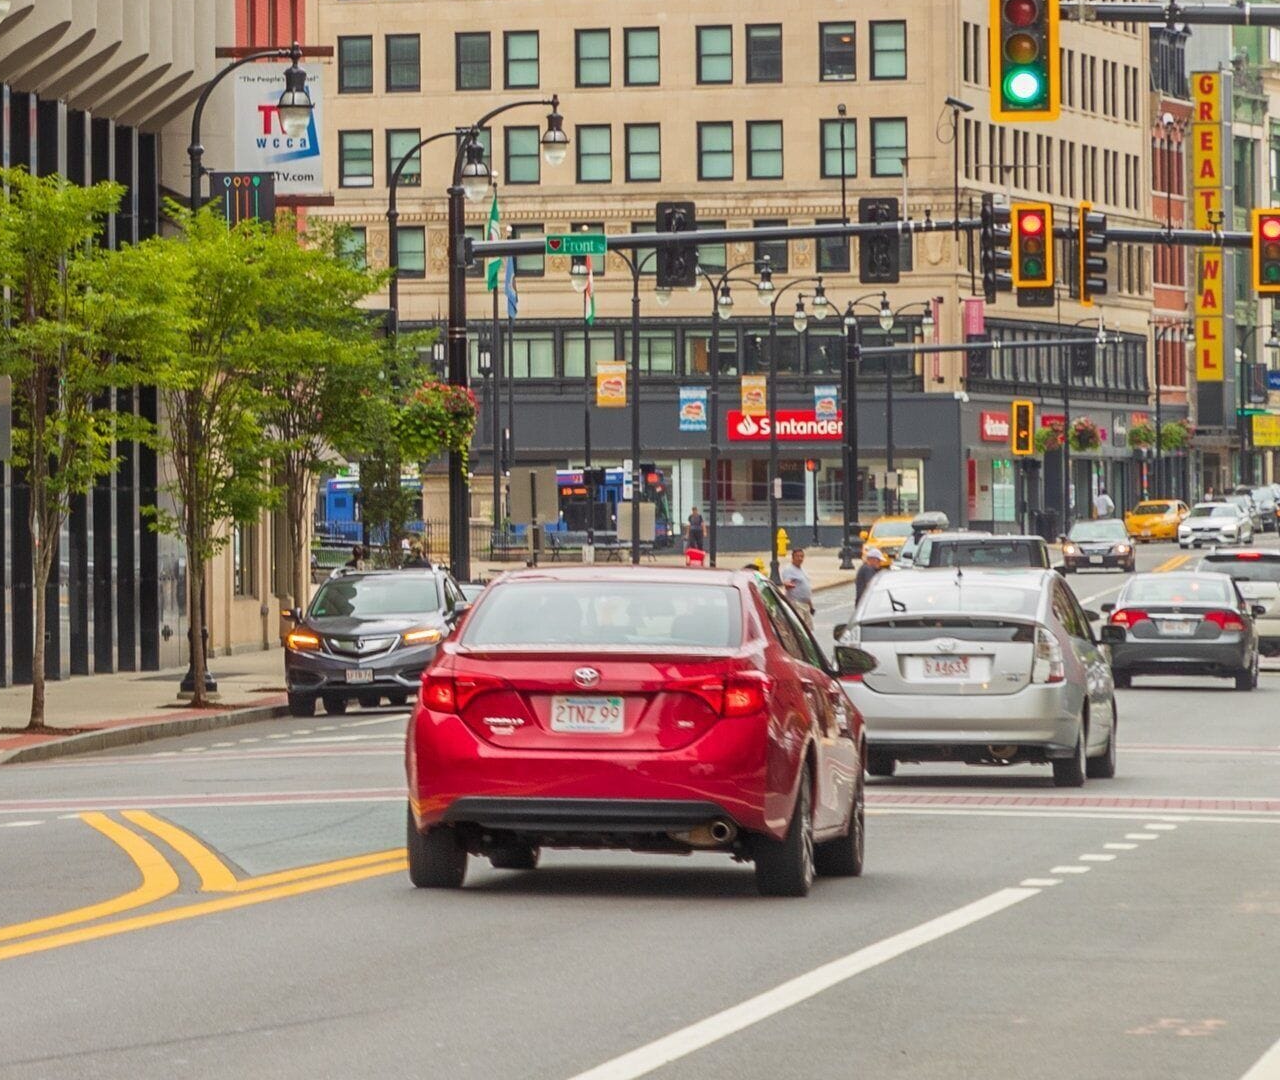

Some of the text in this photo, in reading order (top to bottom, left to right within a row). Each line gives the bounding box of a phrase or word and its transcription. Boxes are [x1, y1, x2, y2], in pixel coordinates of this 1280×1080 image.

[1199, 74, 1219, 370] GREAT WALL
[562, 237, 594, 253] Front
[556, 705, 620, 724] 2TNZ 99
